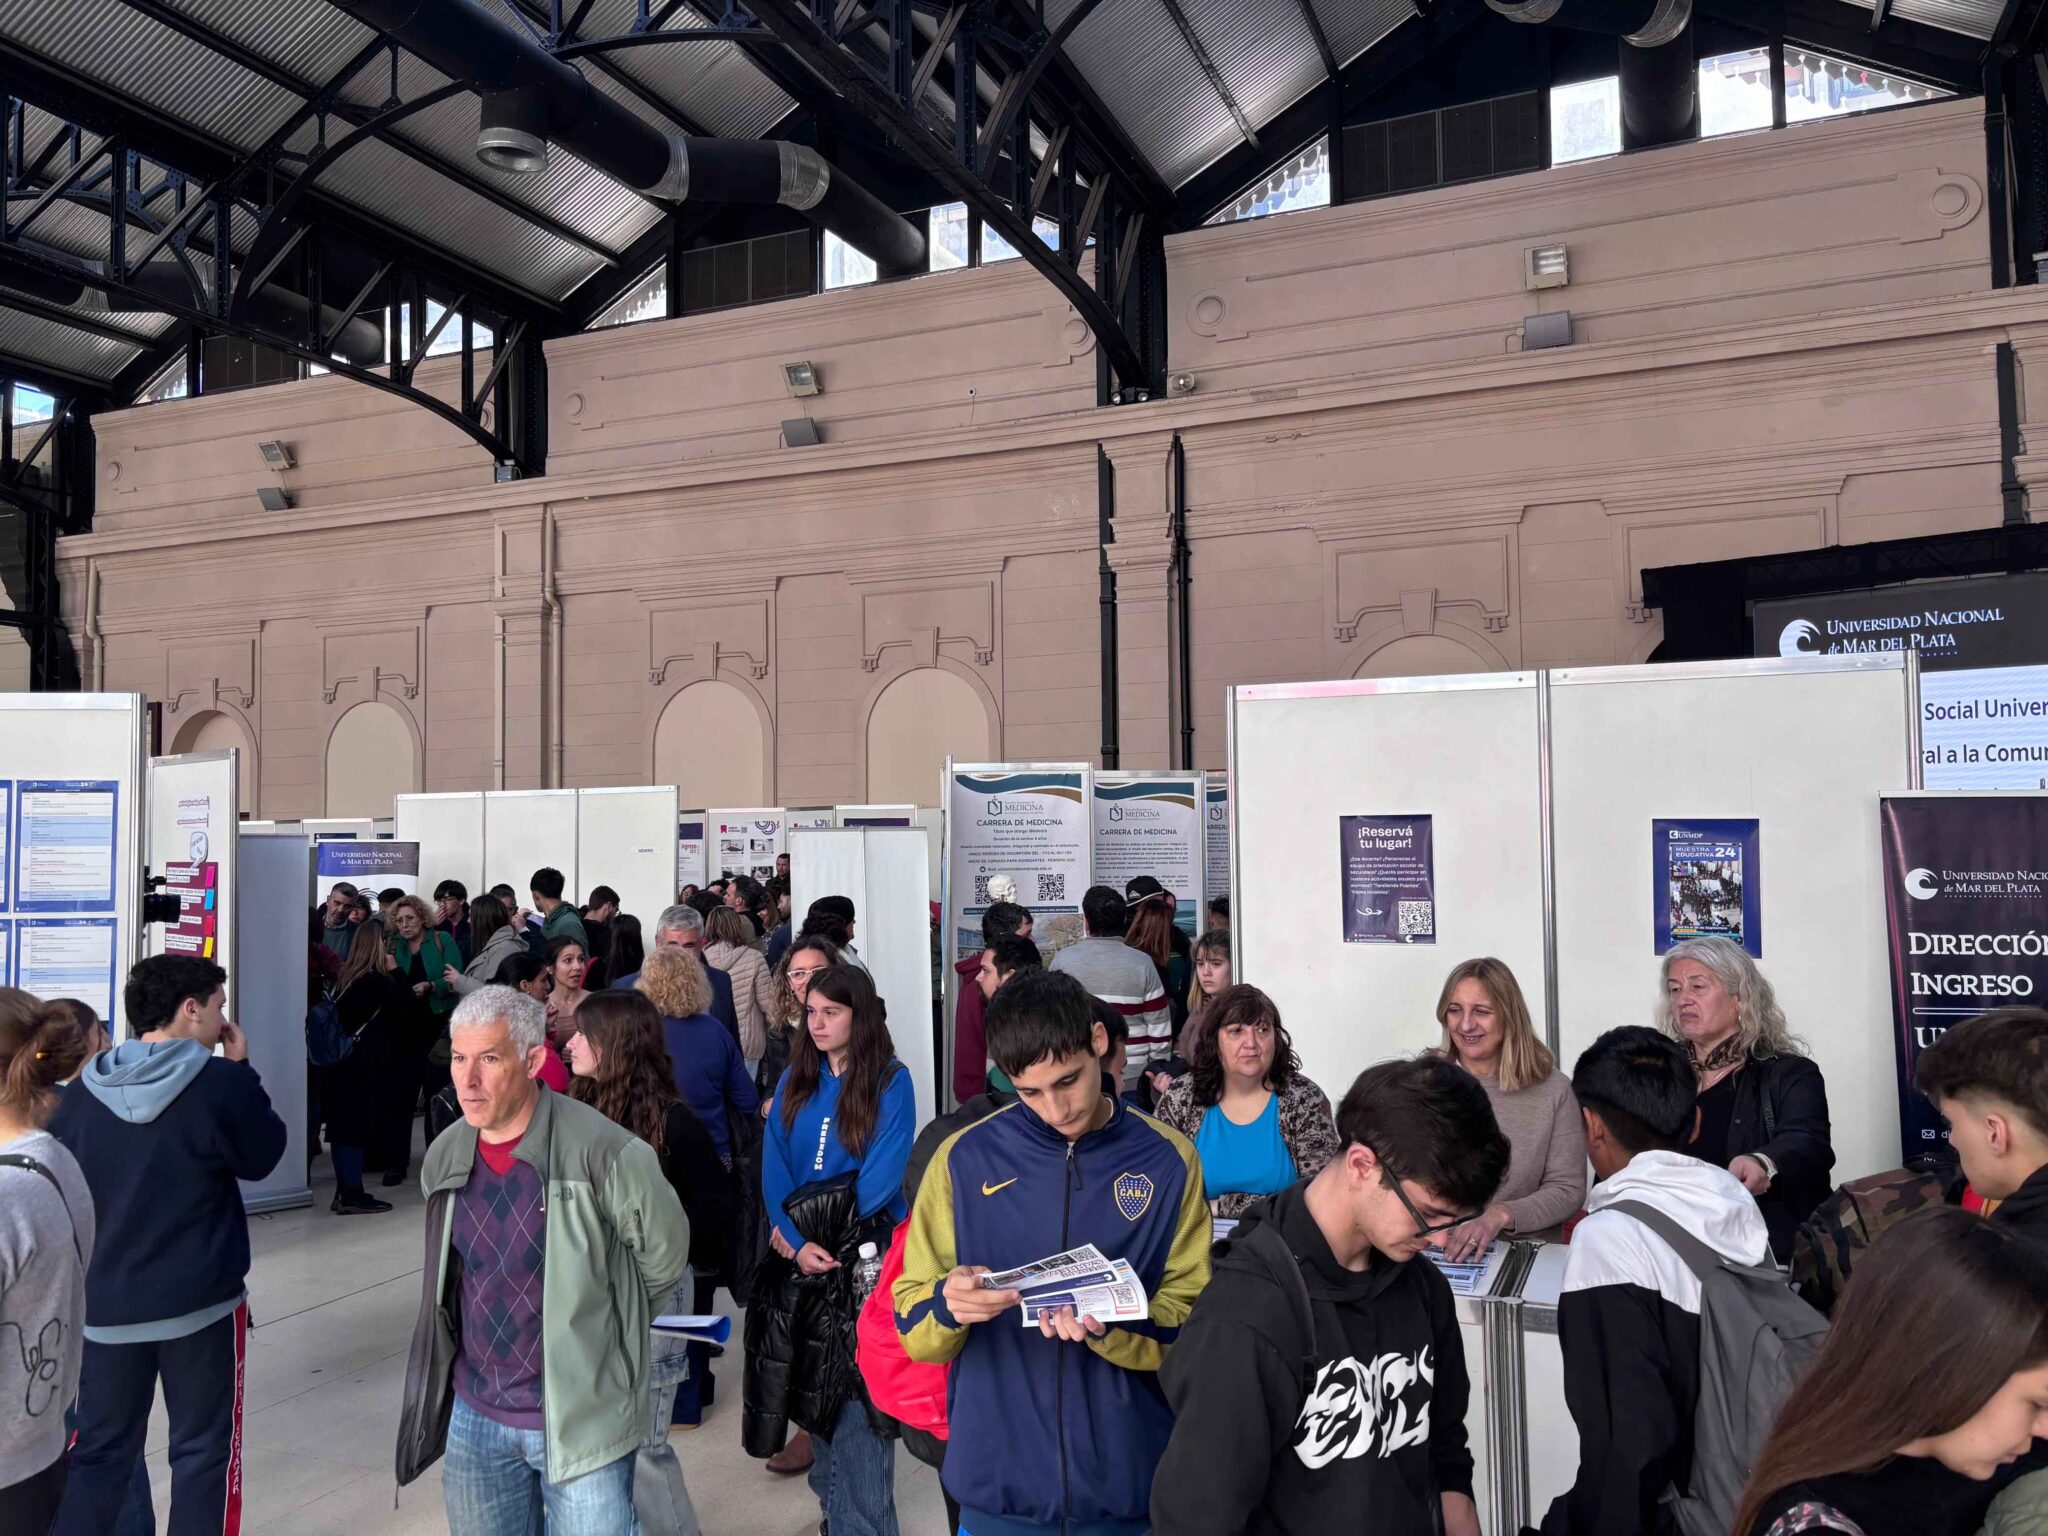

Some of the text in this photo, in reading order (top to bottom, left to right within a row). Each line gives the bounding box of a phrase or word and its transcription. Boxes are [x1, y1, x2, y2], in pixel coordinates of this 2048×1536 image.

[1827, 608, 2004, 635] UNIVERSIDAD NACIONAL
[1843, 639, 1876, 654] MAR
[1881, 637, 1907, 651] DEL
[1910, 634, 1956, 649] PLATA
[1924, 700, 1978, 721] Social
[1922, 745, 1940, 764] al
[1947, 750, 1958, 764] a
[1964, 744, 1979, 764] la
[1358, 825, 1413, 839] ¡Reservá
[1360, 838, 1412, 850] tu lugar!
[1715, 847, 1736, 858] 24
[1942, 870, 2014, 880] UNIVERSIDAD
[1956, 883, 1981, 892] MAR
[1985, 884, 2004, 892] DEL
[2007, 883, 2040, 892] PLATA
[1910, 972, 2033, 996] INGRESO
[1120, 1188, 1147, 1198] CABJ
